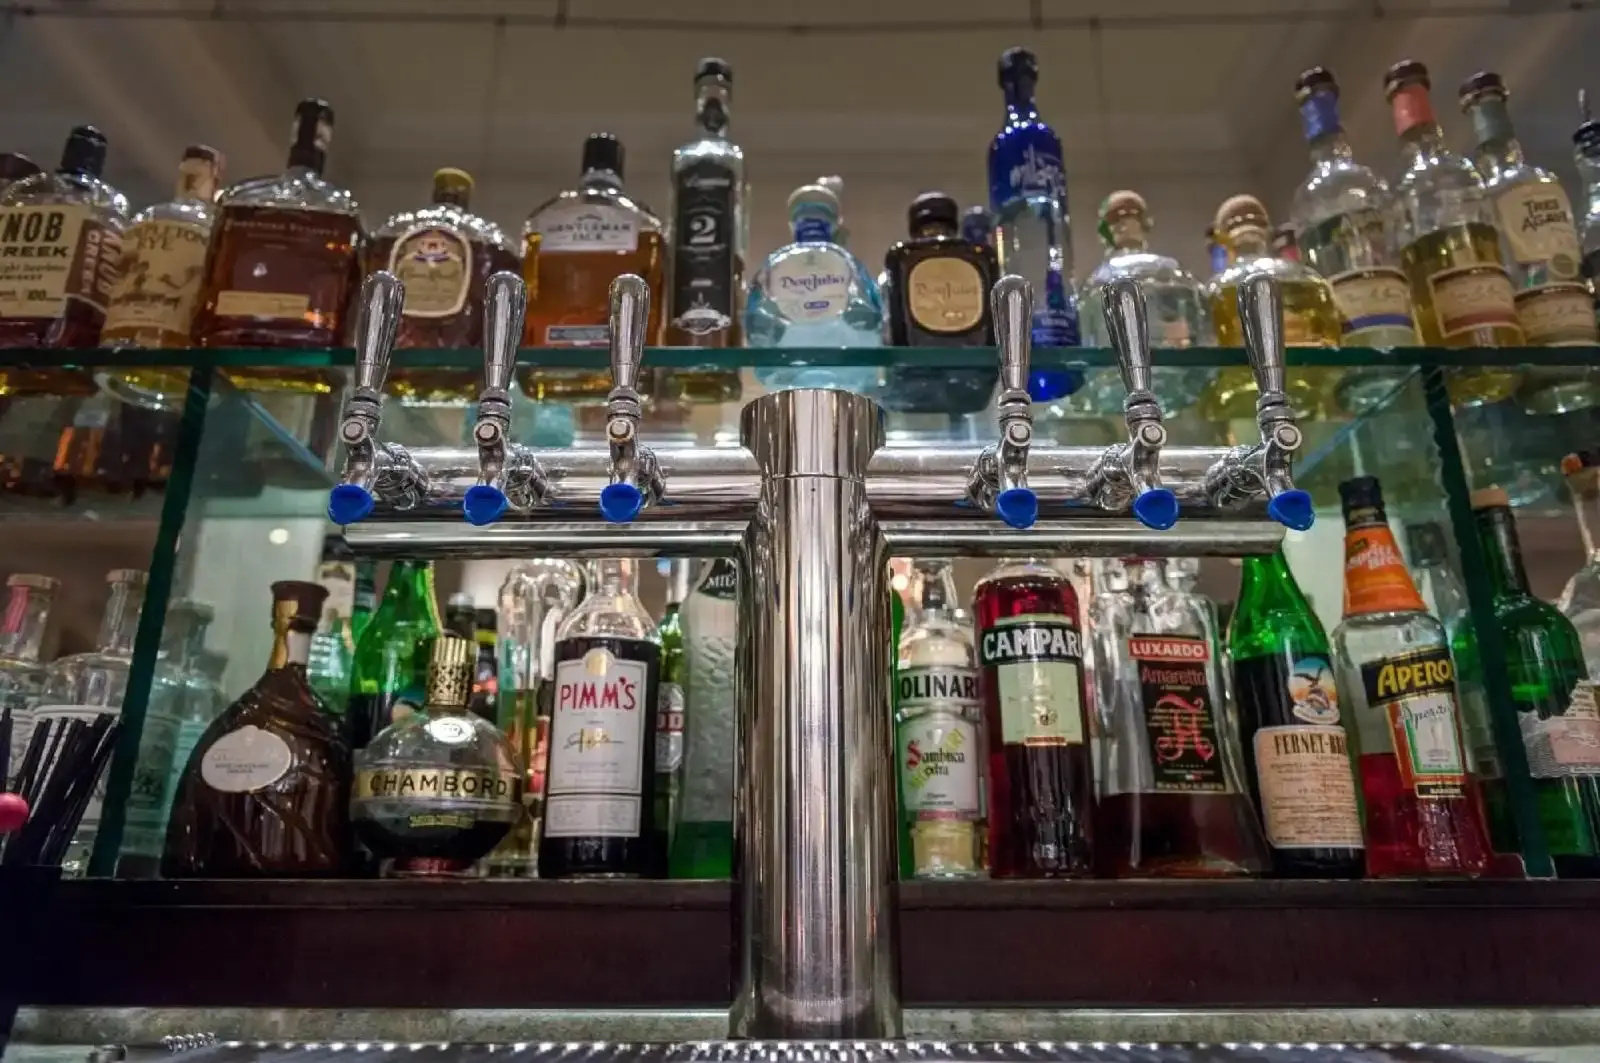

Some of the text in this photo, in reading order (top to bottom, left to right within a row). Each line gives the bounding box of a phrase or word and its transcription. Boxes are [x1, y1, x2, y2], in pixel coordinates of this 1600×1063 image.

[690, 214, 716, 244] 2
[0, 246, 70, 258] REEK
[1131, 641, 1204, 657] LUXARDO
[560, 676, 637, 713] PIMM'S
[369, 774, 508, 796] CHAMBORD
